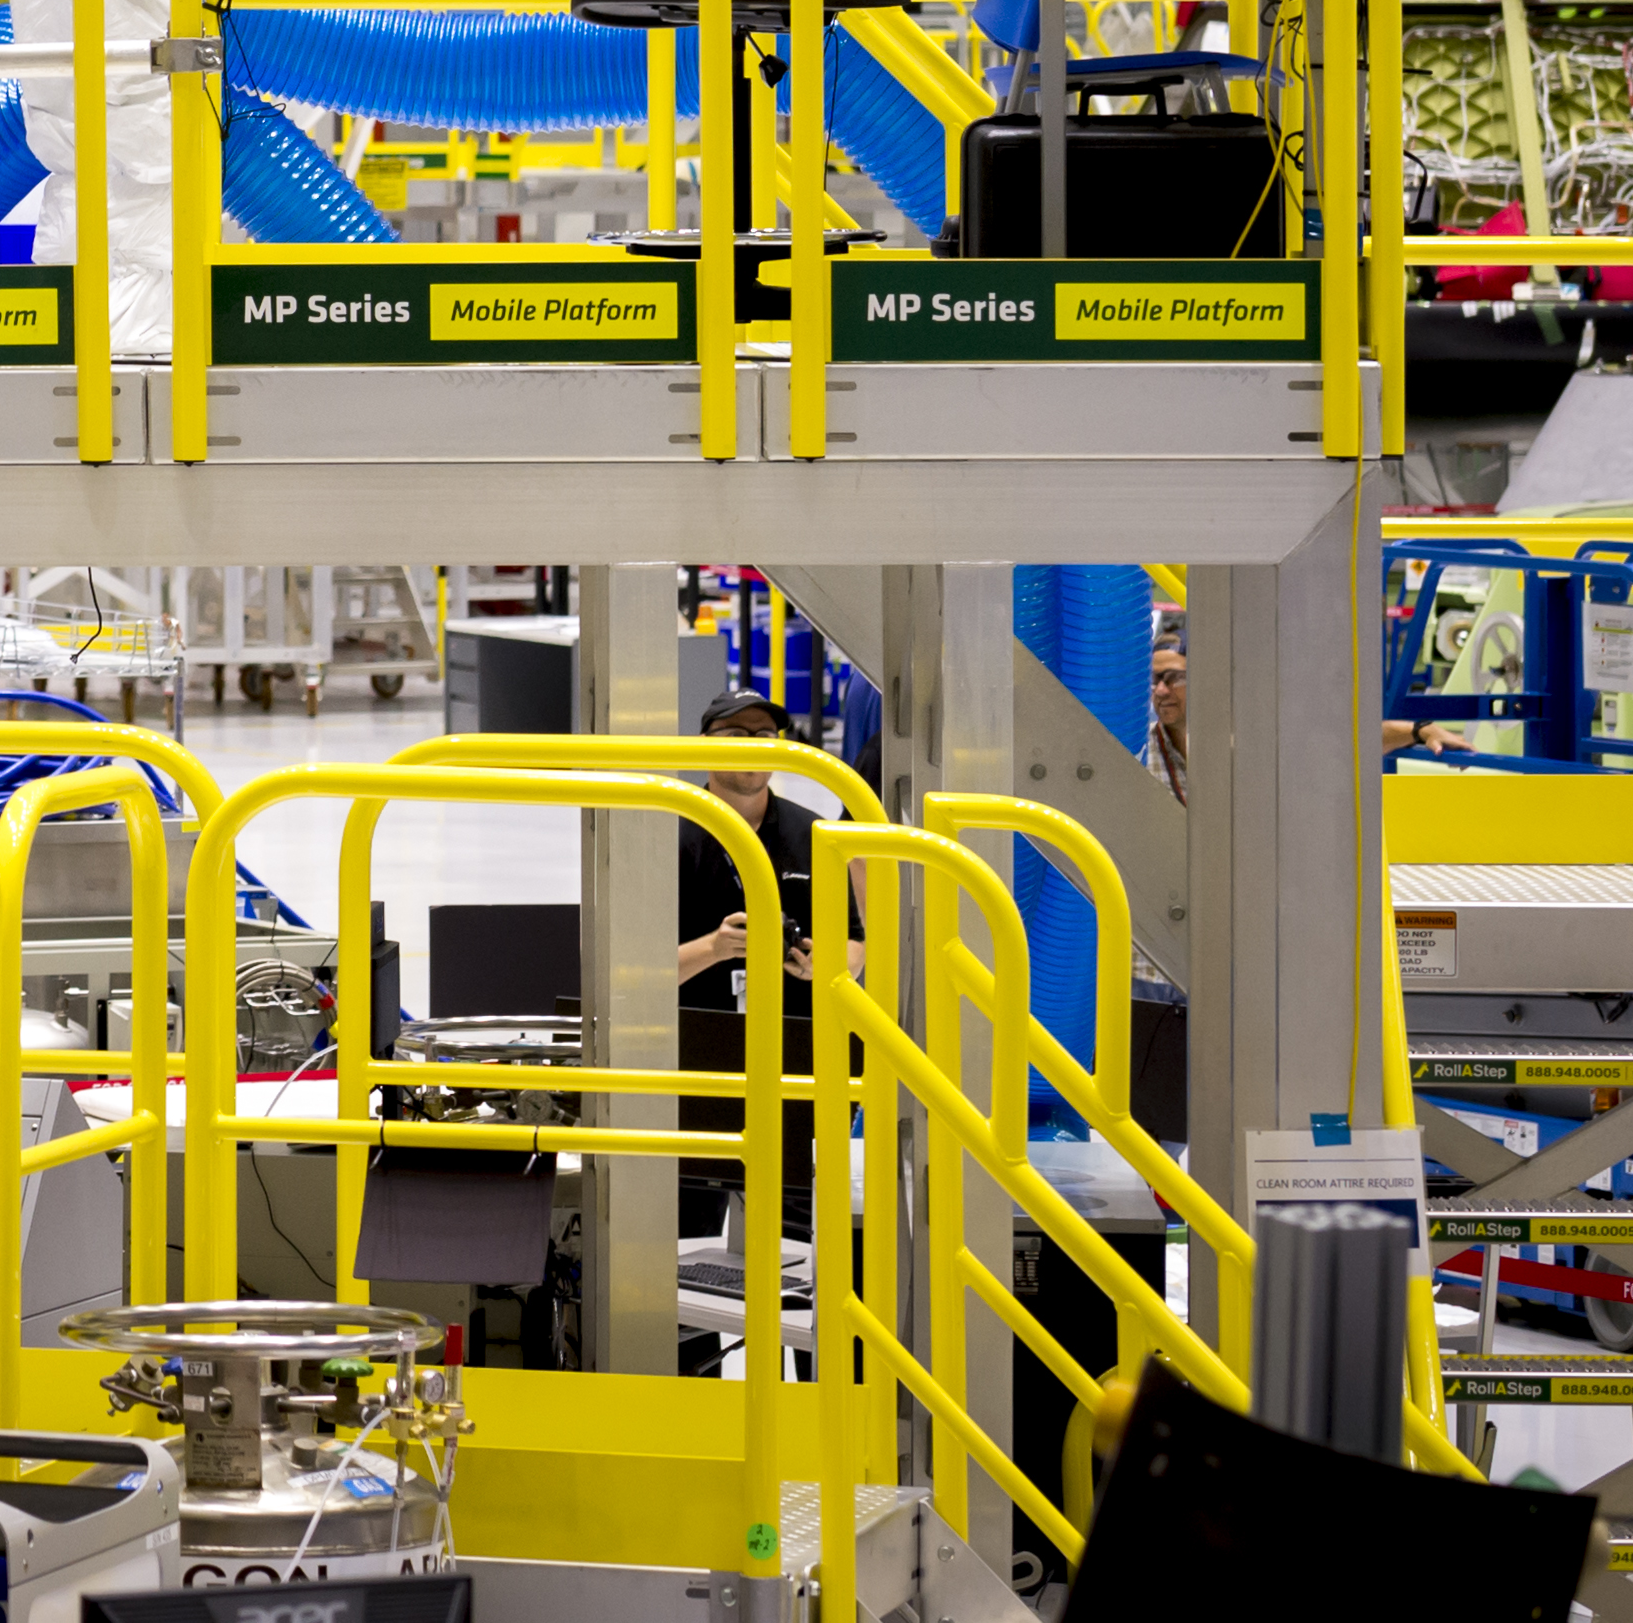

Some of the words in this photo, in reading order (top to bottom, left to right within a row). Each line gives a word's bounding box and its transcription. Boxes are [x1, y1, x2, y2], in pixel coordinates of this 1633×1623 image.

[244, 295, 297, 323] MP
[308, 293, 410, 323] Series
[451, 298, 536, 322] Mobile
[544, 298, 657, 326] Platform
[867, 293, 920, 322] MP
[932, 292, 1035, 322] Series
[1076, 298, 1162, 322] Mobile
[1170, 298, 1284, 327] Platform
[1404, 916, 1453, 925] WARNING
[1412, 930, 1433, 938] NOT
[1401, 966, 1447, 974] APACITY.
[1434, 1063, 1507, 1079] RollAStep
[1526, 1066, 1621, 1078] 888.948.0005
[1256, 1179, 1289, 1189] CLEAN
[1293, 1179, 1326, 1188] ROOM
[1330, 1179, 1364, 1188] ATTIRE
[1368, 1178, 1414, 1189] REQUIRED
[1447, 1222, 1521, 1238] RollAStep
[187, 1363, 211, 1375] 671
[1467, 1381, 1542, 1398] RollAStep
